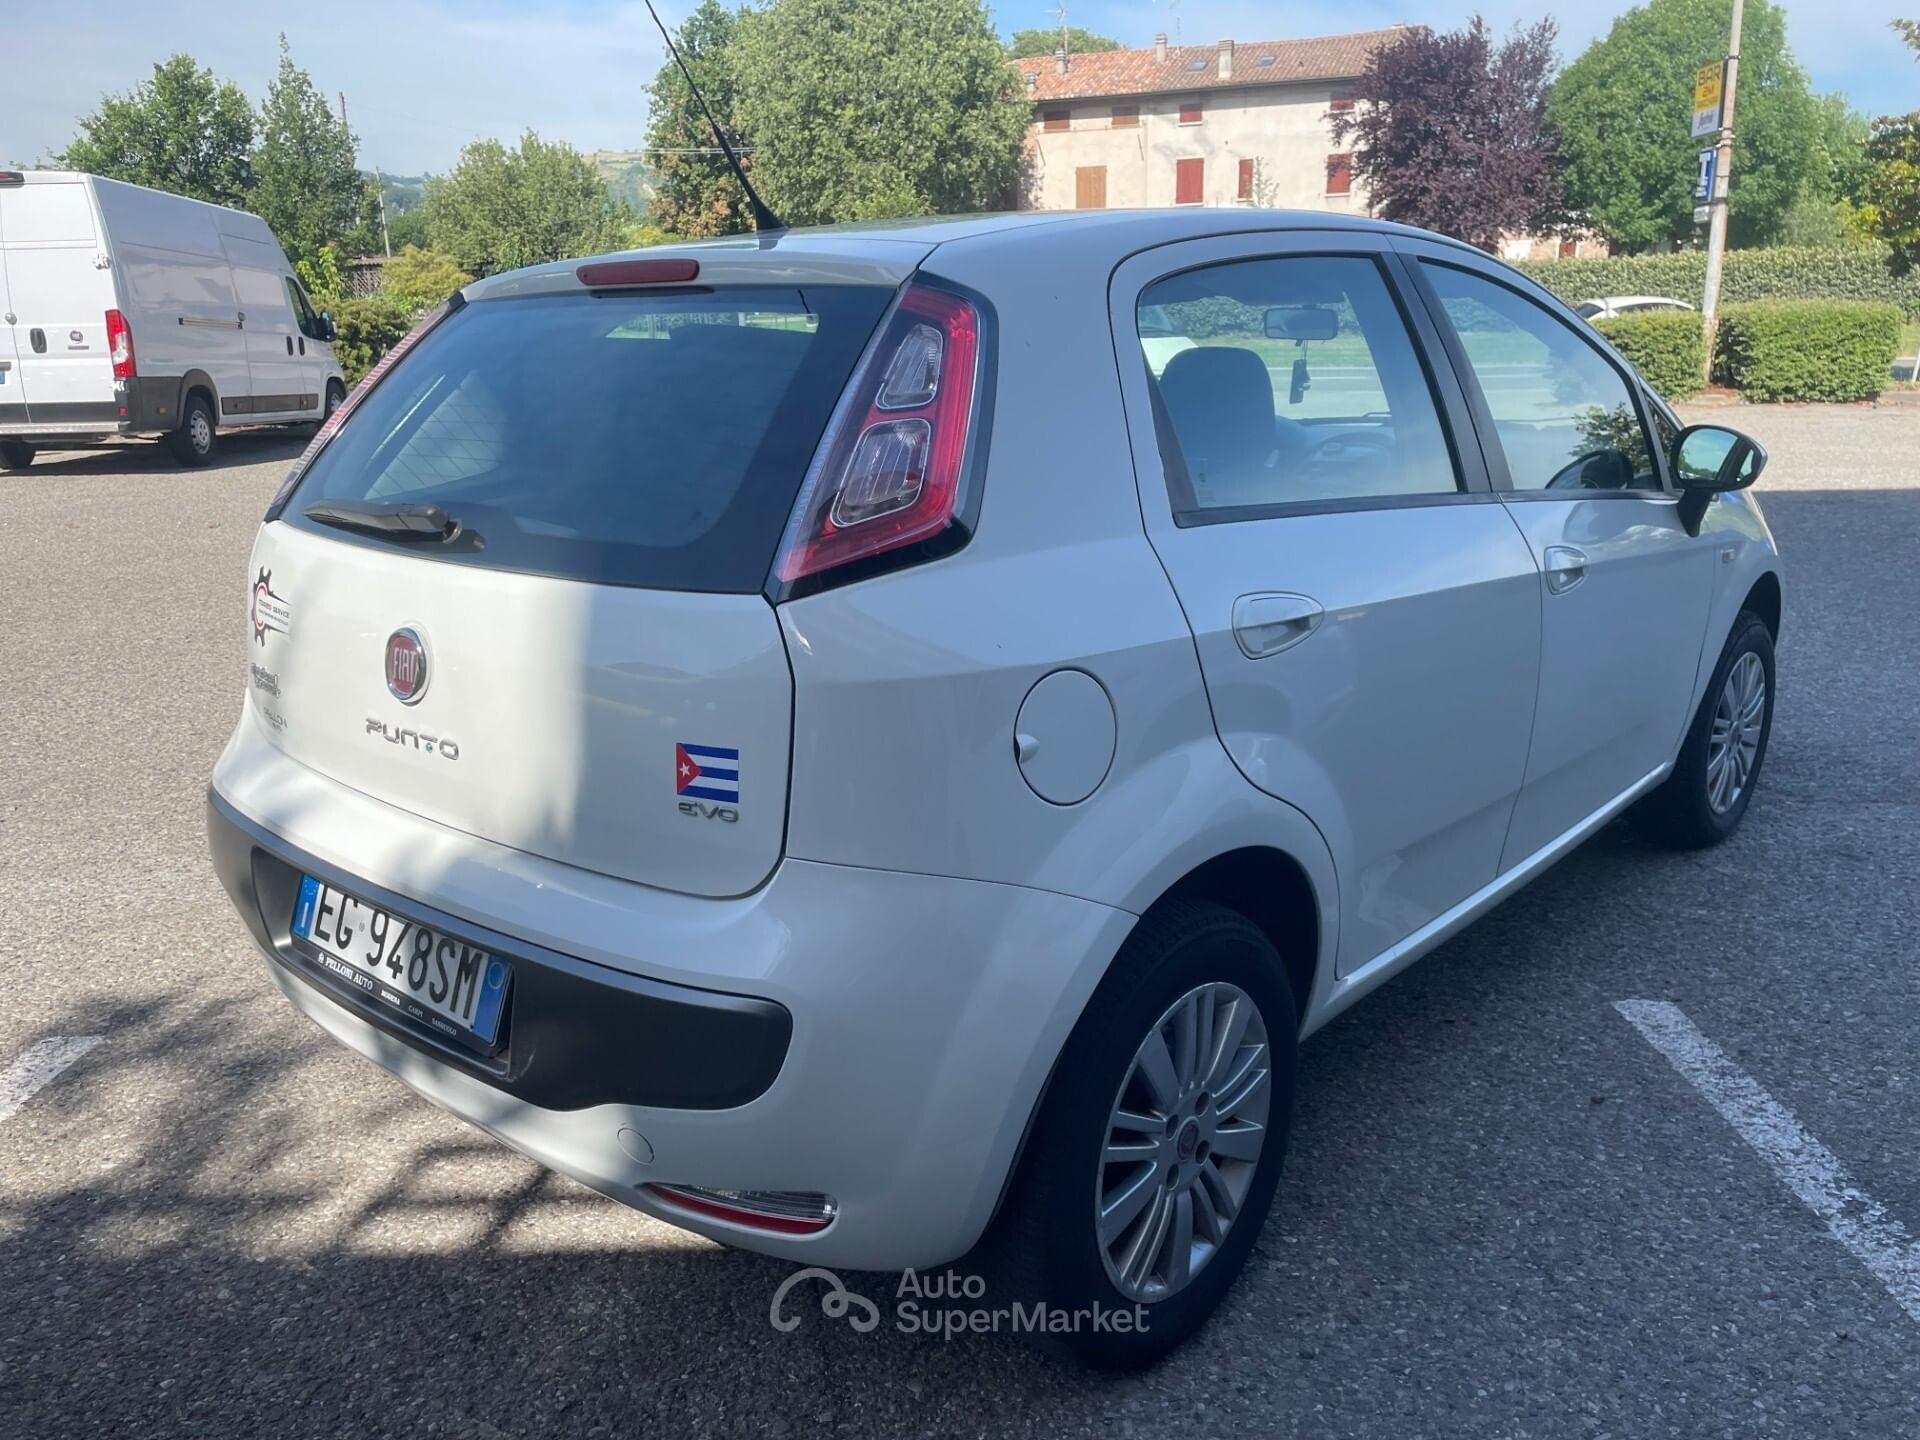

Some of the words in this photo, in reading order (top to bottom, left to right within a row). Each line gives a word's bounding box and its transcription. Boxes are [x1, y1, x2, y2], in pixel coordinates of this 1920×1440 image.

[1698, 65, 1721, 86] BAR
[393, 647, 417, 681] FIAT
[365, 717, 459, 760] PUNTO
[678, 802, 739, 822] EVO
[314, 885, 359, 950] EG
[366, 907, 484, 1020] 948SM
[325, 956, 354, 980] PELLONI
[353, 973, 374, 991] AUTO
